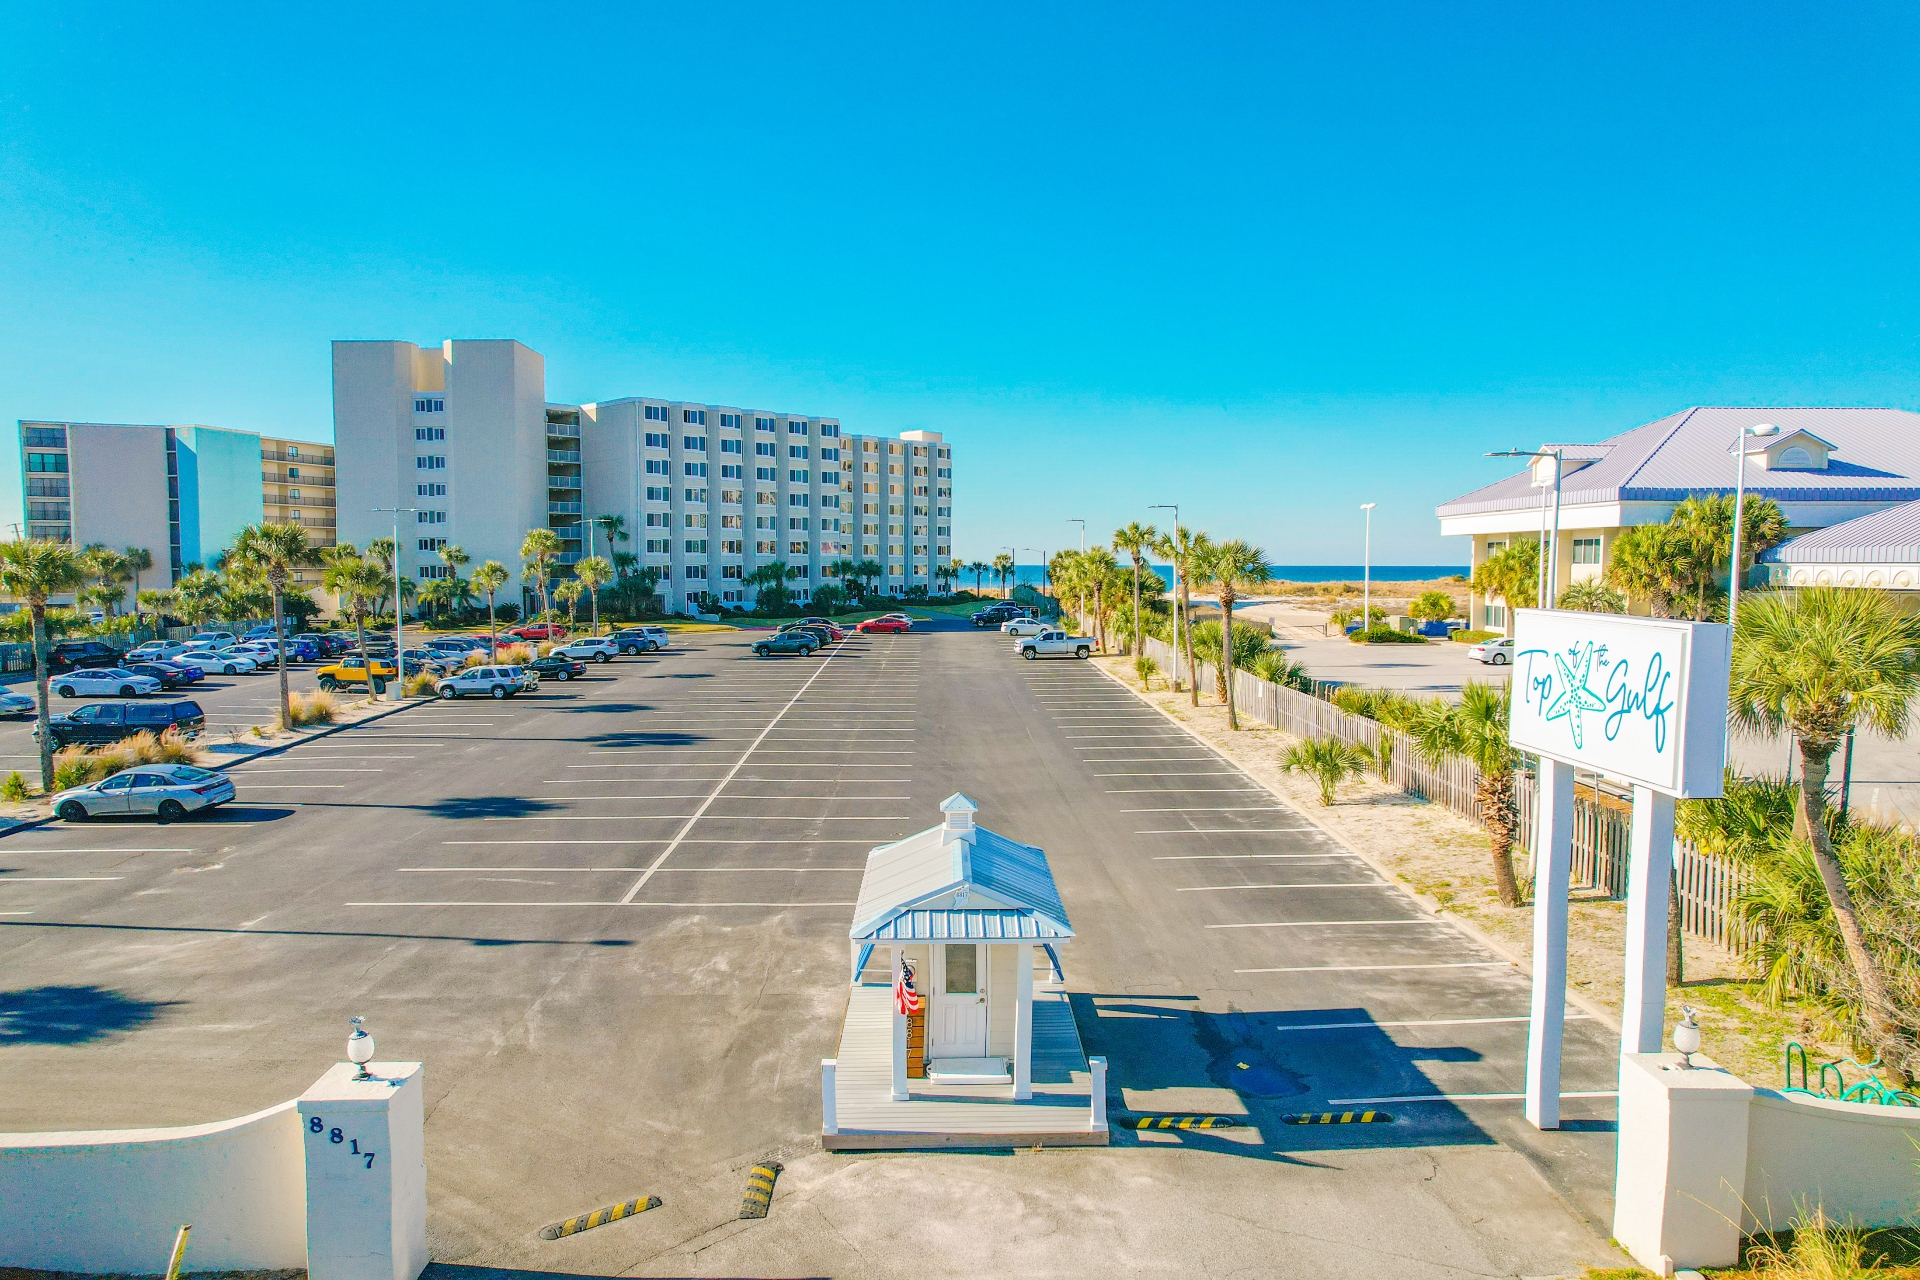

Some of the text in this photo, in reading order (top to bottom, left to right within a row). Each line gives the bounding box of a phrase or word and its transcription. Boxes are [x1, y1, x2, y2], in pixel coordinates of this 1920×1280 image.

[1517, 640, 1674, 754] Top of the Gulf
[309, 1116, 376, 1170] 8817
